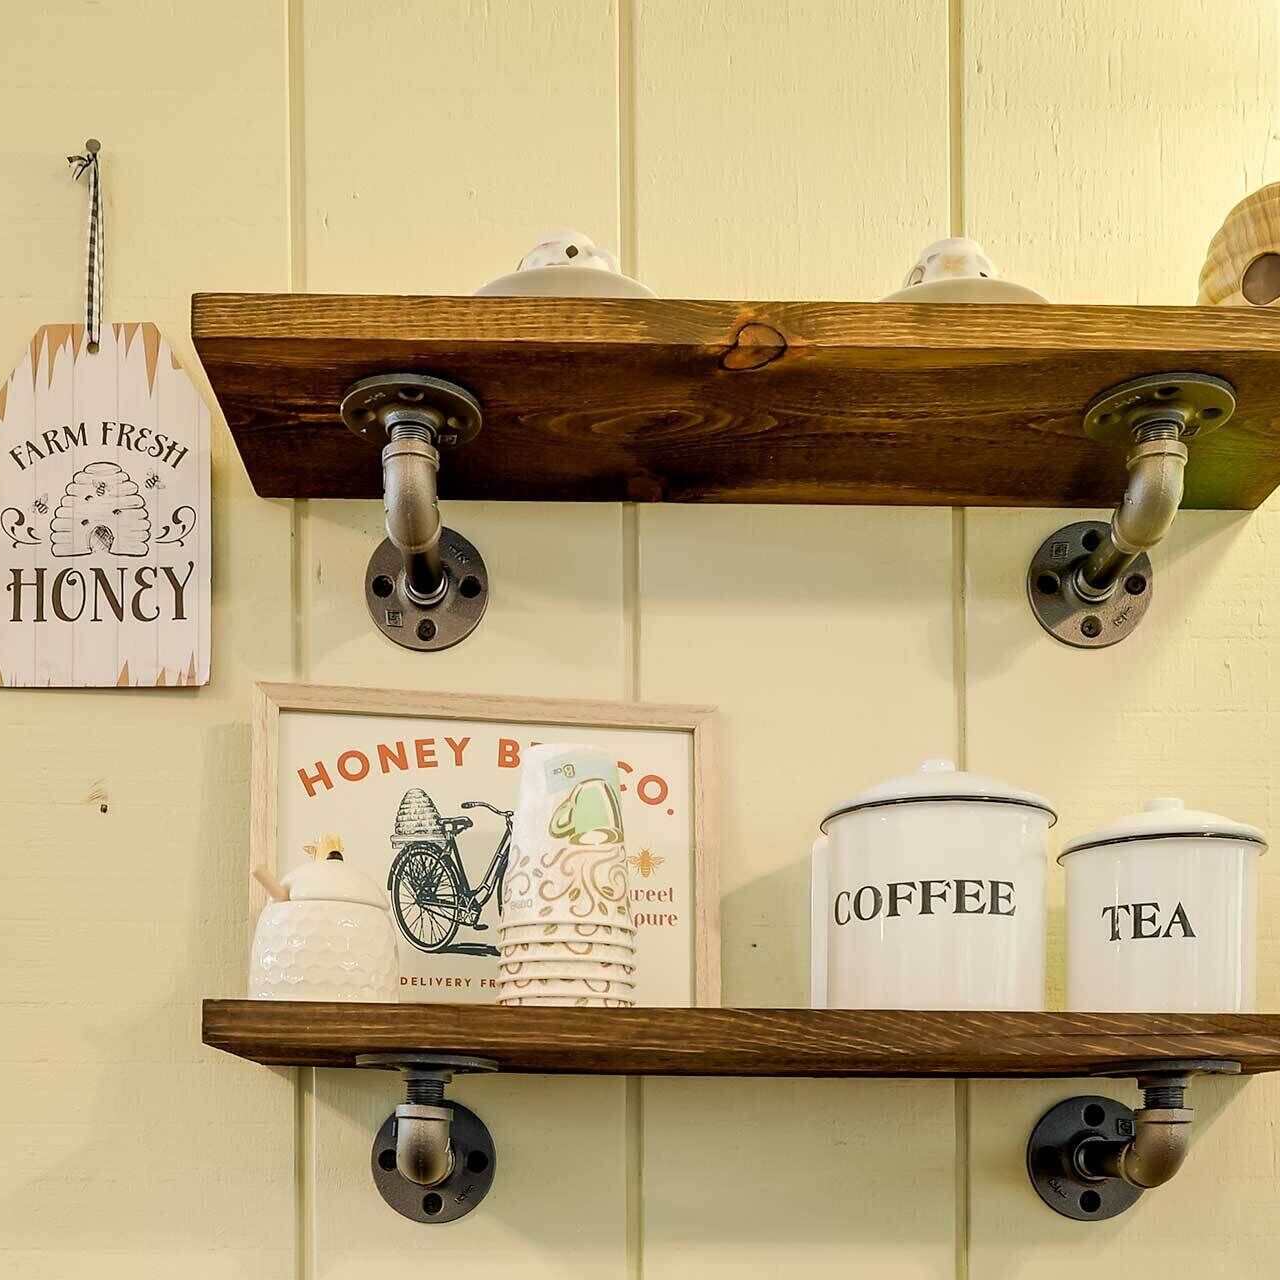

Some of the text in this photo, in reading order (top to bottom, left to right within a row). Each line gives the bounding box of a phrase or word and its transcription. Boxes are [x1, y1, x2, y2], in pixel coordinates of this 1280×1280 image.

[8, 421, 189, 471] FARM FRESH
[6, 560, 195, 623] HONEY
[296, 736, 471, 798] HONEY
[629, 887, 674, 904] weet
[833, 879, 1017, 926] COFFEE
[634, 911, 679, 928] pure
[1102, 901, 1197, 942] TEA
[399, 976, 497, 989] DELIVERY FR
